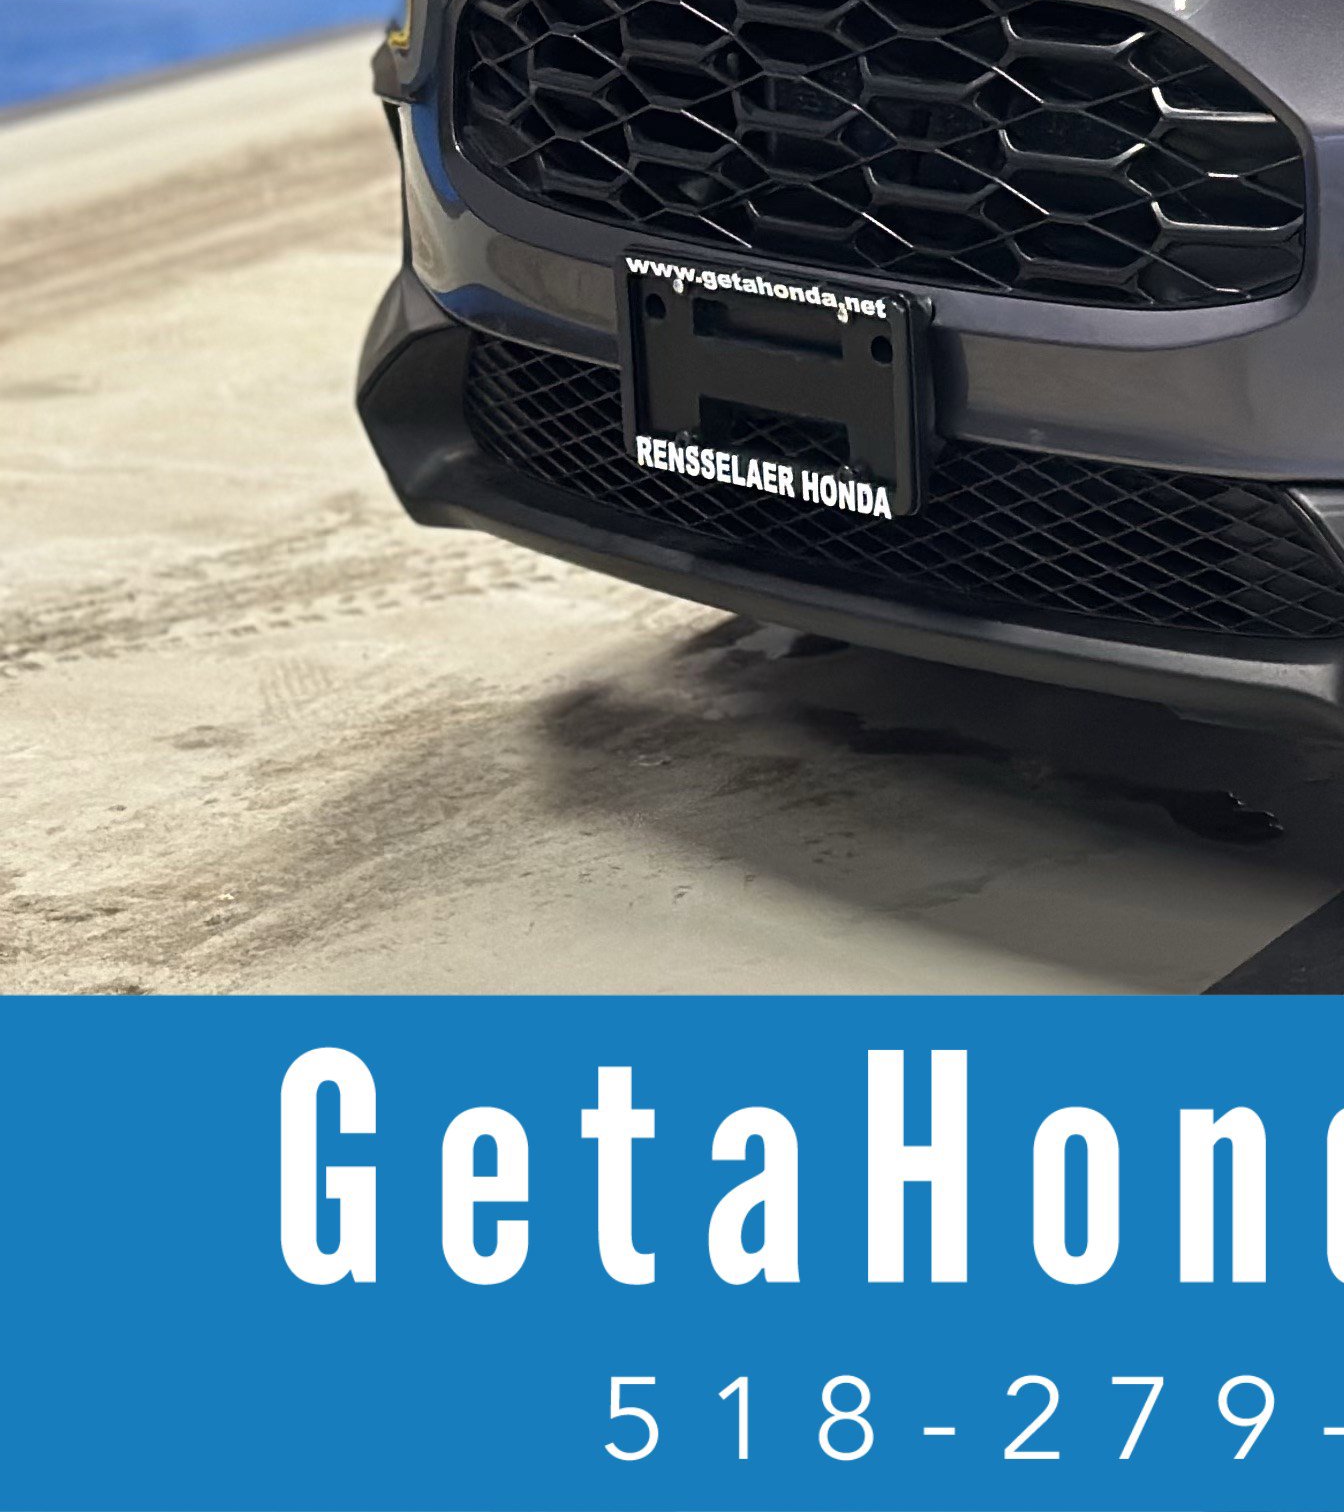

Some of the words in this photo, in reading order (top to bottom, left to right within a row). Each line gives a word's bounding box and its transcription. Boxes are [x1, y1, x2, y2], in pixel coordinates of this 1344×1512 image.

[625, 256, 887, 319] www.getahonda.net
[635, 435, 796, 499] RENSSELAER
[801, 469, 893, 521] HONDA
